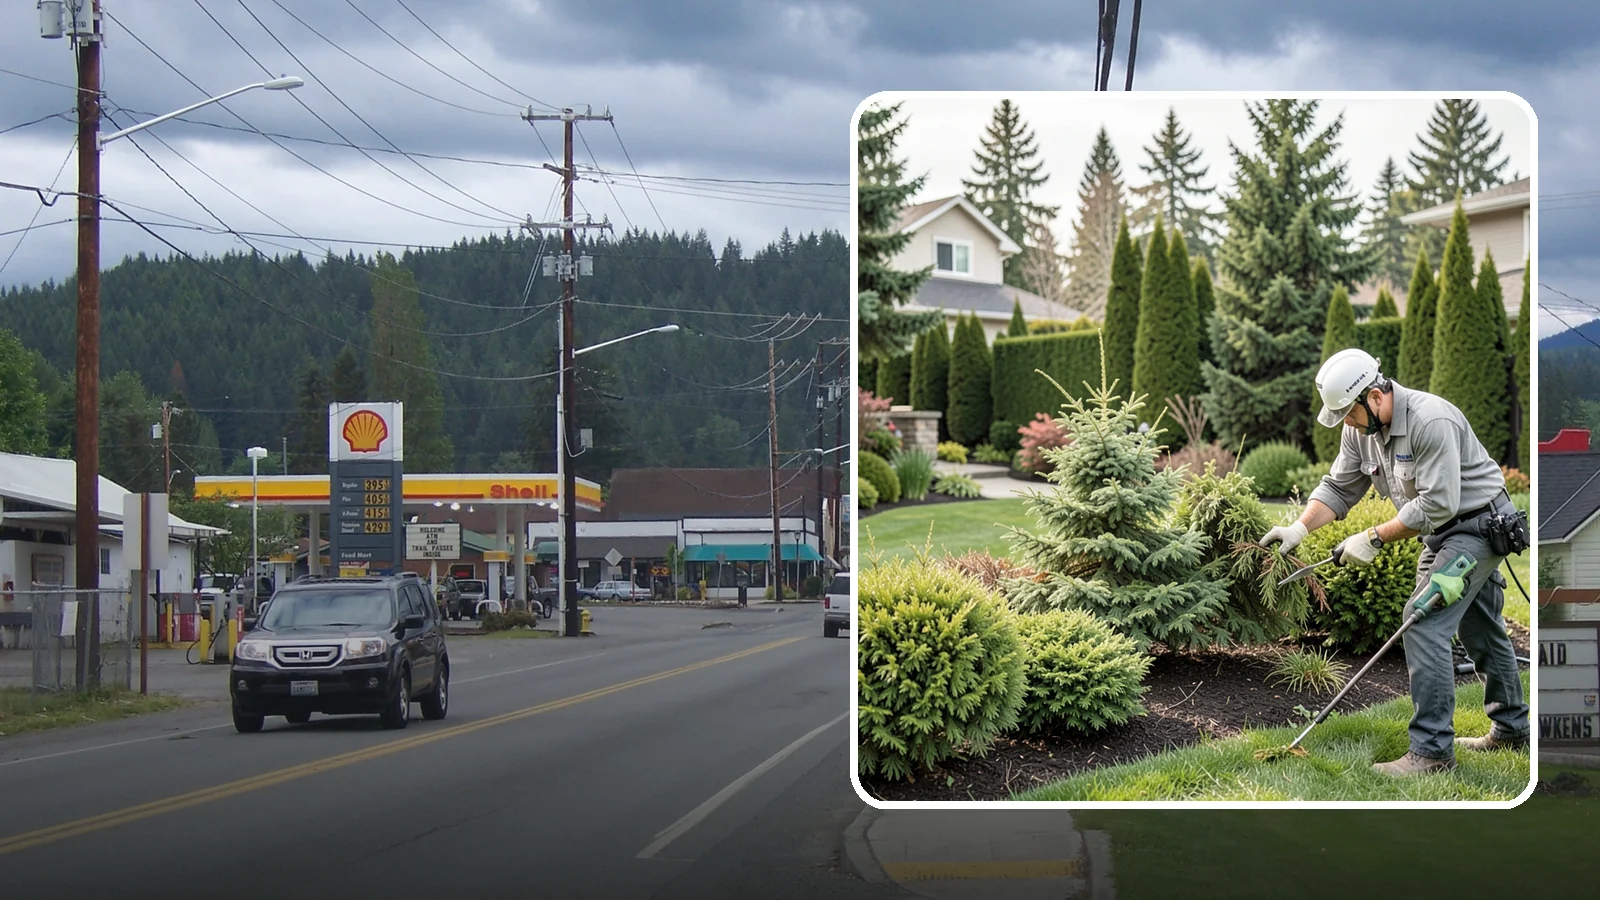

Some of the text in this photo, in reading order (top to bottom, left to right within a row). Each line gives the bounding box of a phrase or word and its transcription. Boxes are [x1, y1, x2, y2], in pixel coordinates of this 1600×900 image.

[365, 480, 384, 490] 395
[490, 484, 547, 499] Shell
[365, 494, 384, 504] 405
[365, 508, 384, 518] 415
[365, 522, 384, 533] 429
